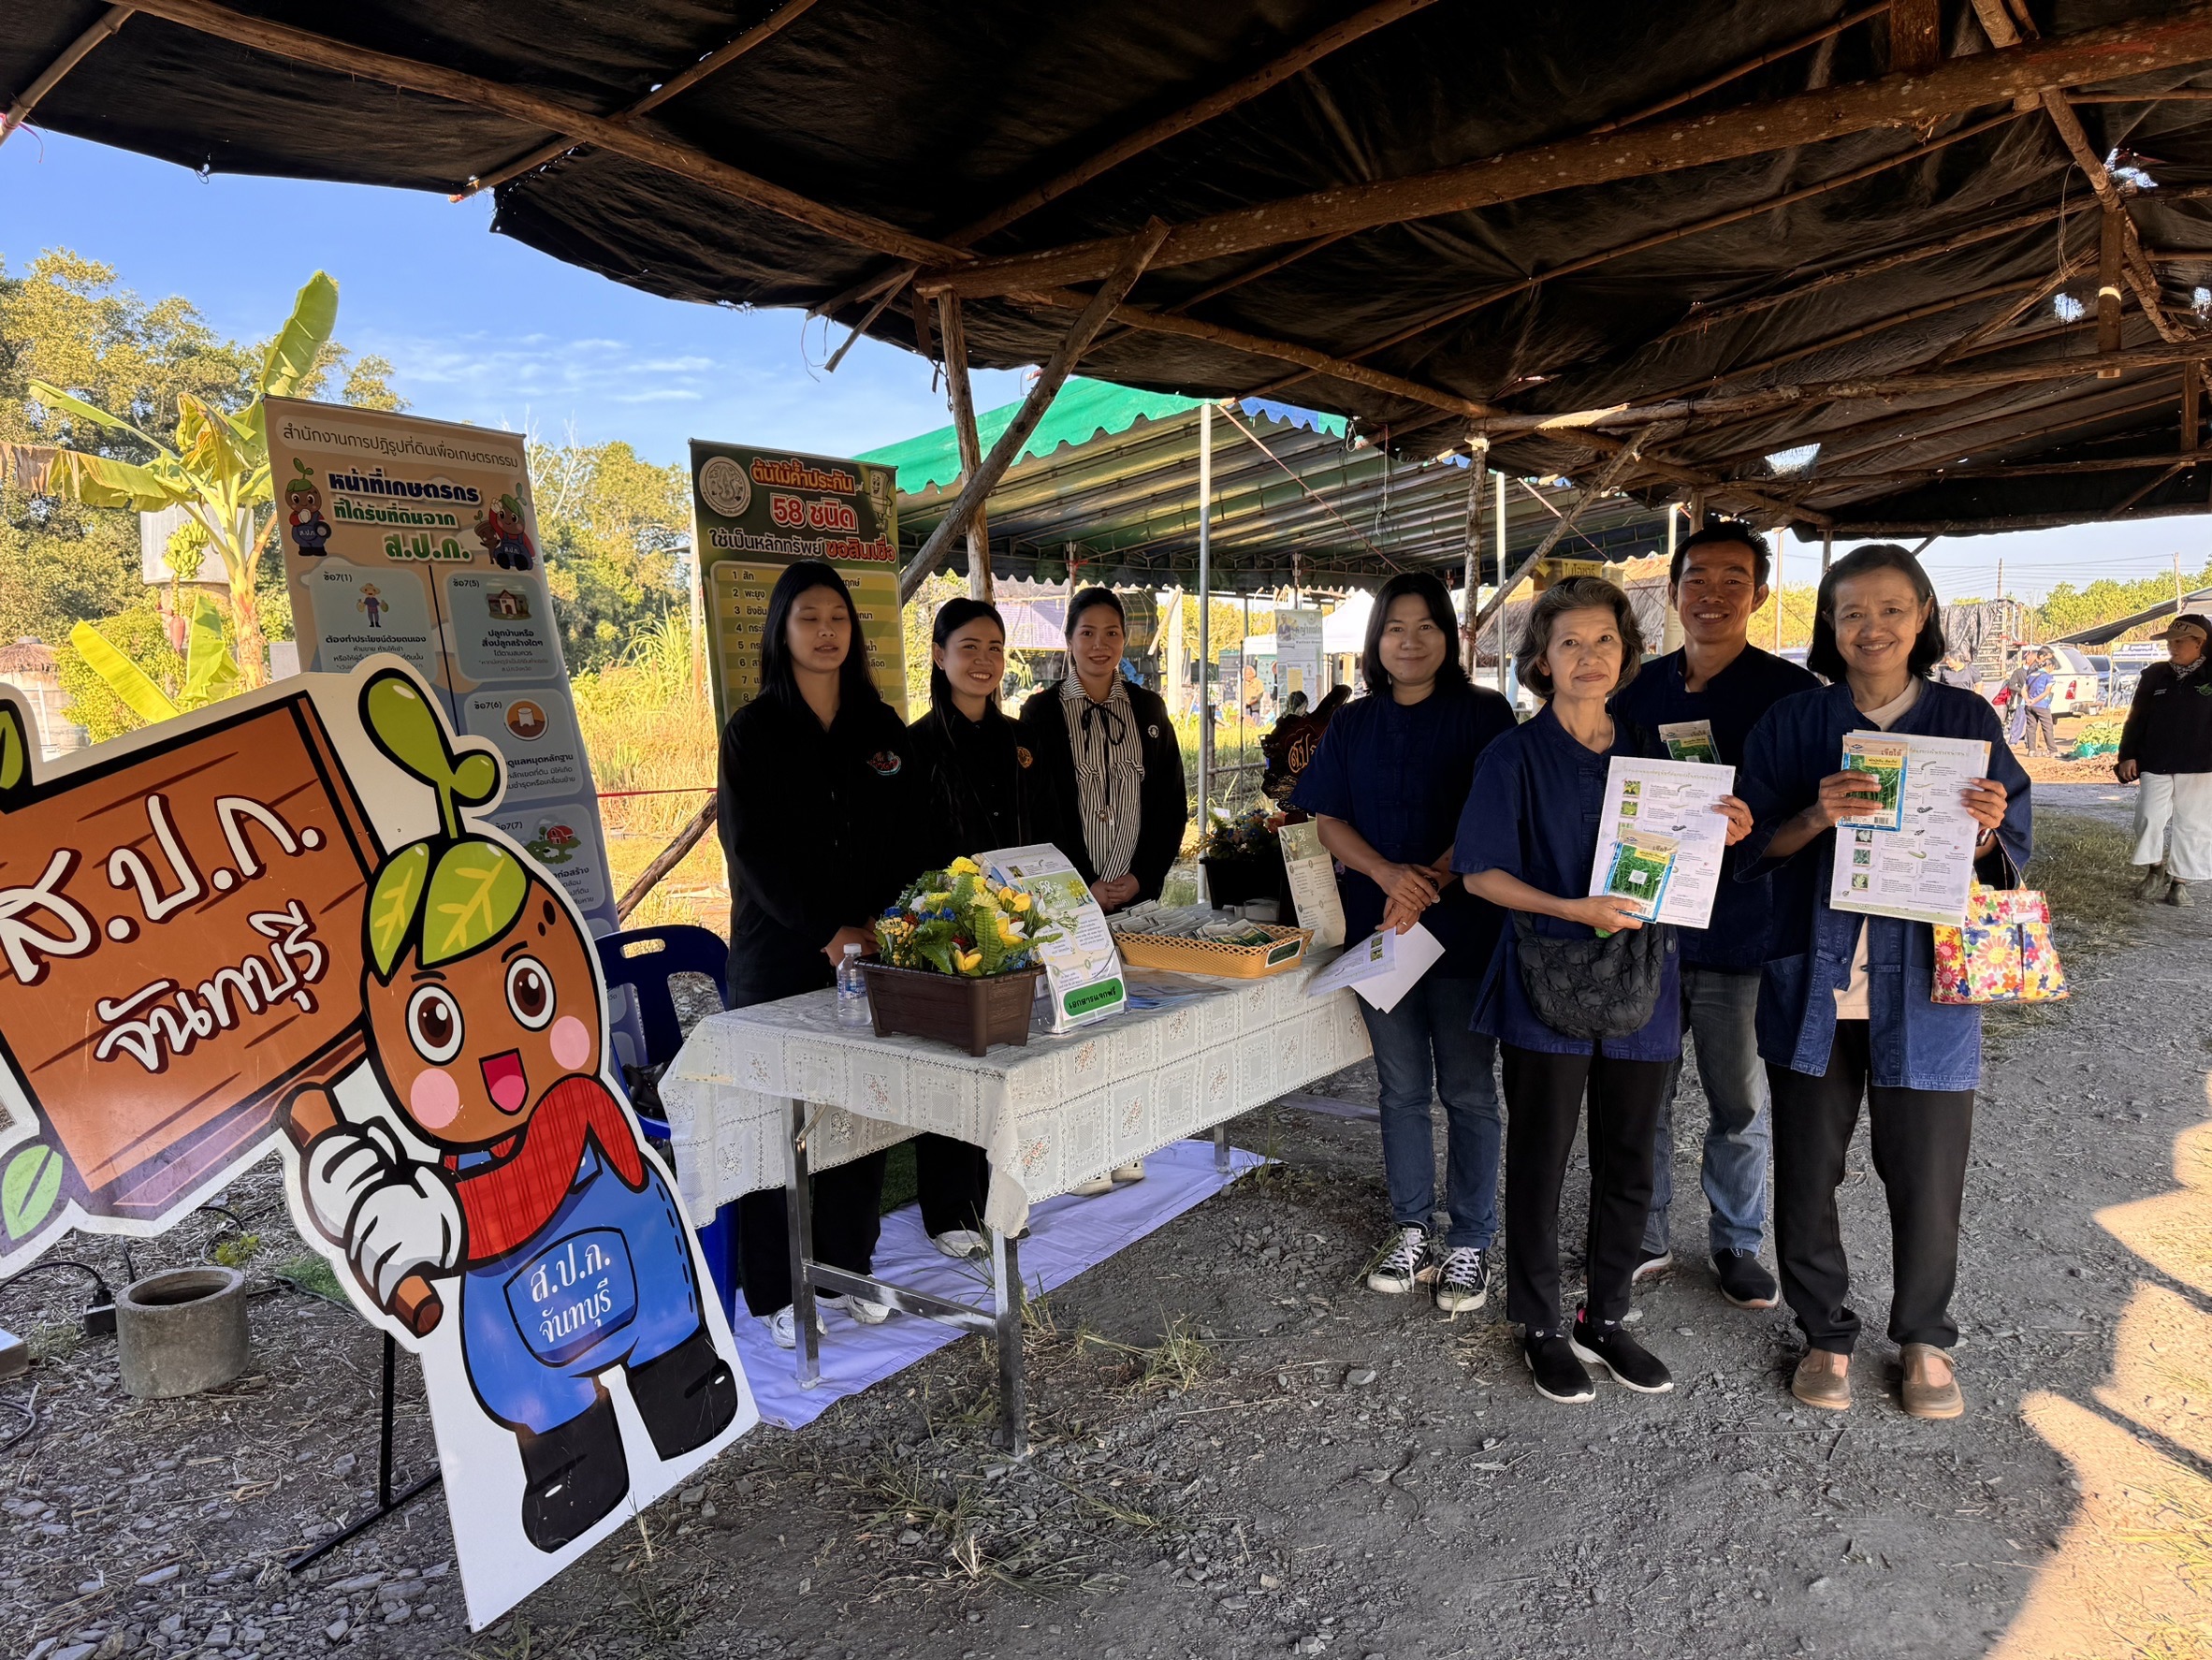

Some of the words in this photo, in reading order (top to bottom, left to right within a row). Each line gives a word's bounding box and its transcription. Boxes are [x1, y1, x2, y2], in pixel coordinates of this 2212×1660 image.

[284, 423, 518, 468] สำนักงานการปฏิรูปที่ดินเพื่อเกษตรกรรม
[751, 458, 854, 492] ต้นไม้ค้ำประกัน
[328, 468, 479, 502] หน้าที่เกษตรกร
[333, 498, 456, 526] ที่ได้รับที่ดินจาก
[772, 496, 806, 524] 58
[808, 499, 856, 531] ชนิด
[384, 531, 472, 560] ส.ป.ก.
[709, 529, 823, 557] ใช้เป็นหลักทรัพย์
[824, 534, 896, 562] ขอสินเชื่อ
[733, 571, 737, 579] 1
[743, 570, 754, 580] สัก
[733, 589, 739, 597] 2
[745, 590, 765, 601] พะยูง
[735, 605, 740, 615] 3
[736, 623, 742, 632] 4
[326, 634, 427, 644] ต้องทำประโยชน์ด้วยตนเอง
[738, 641, 745, 649] 5
[739, 659, 746, 667] 6
[870, 659, 885, 667] ลือด
[741, 676, 748, 684] 7
[473, 700, 502, 709] ข้อ7(6)
[743, 693, 749, 702] 8
[506, 753, 574, 767] ดูแลหมุดหลักฐาน
[506, 776, 576, 790] มชำรุดหรือเคลื่อนย้าย
[0, 793, 325, 983] ส.ป.ก.
[95, 898, 327, 1071] จันทบุรี
[531, 1243, 611, 1303] ส.ป.ก.
[539, 1277, 612, 1344] จันทบุรี
